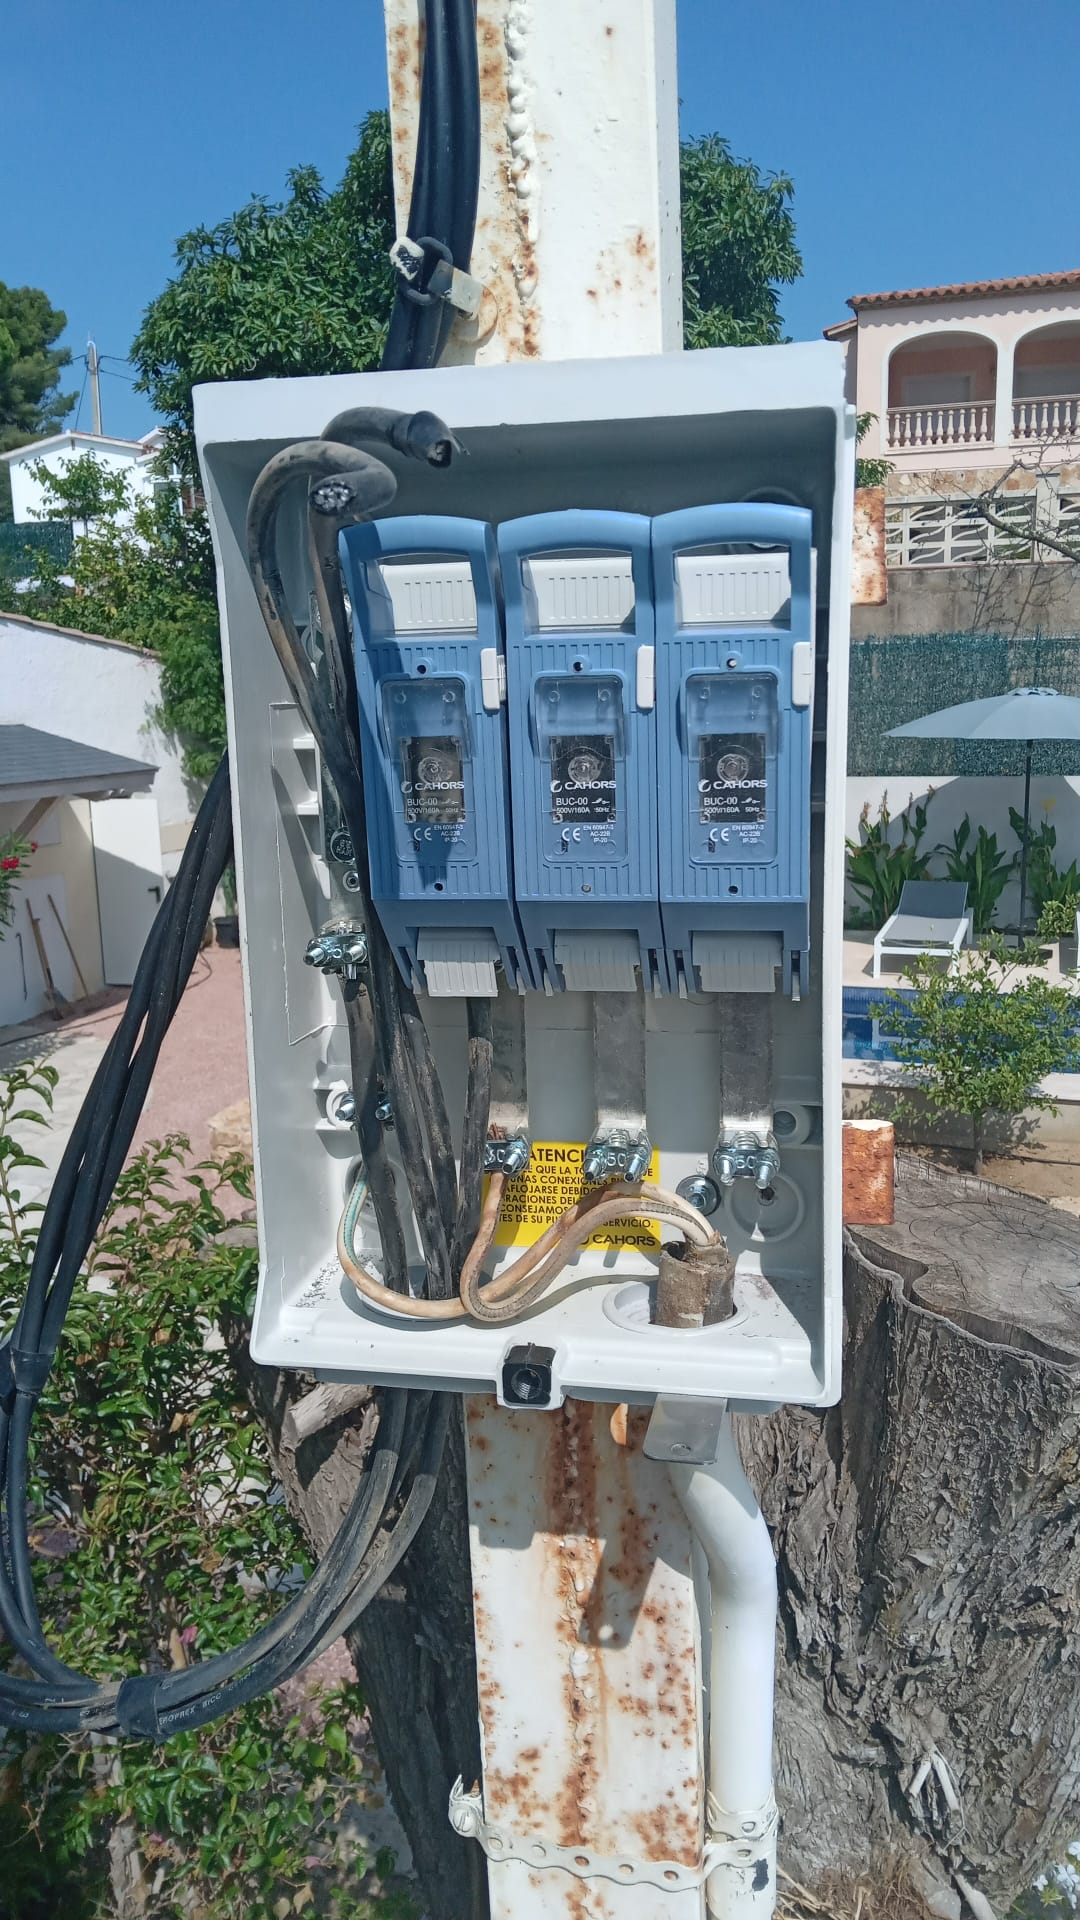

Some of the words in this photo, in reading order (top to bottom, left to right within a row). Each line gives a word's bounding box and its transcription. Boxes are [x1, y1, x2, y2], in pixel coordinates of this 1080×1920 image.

[414, 781, 465, 790] CAHORS
[565, 781, 617, 790] CAHORS
[713, 780, 768, 790] CAHORS
[407, 798, 438, 806] BUC-00
[556, 797, 588, 806] BUC-00
[703, 797, 738, 806] BUC-00
[414, 827, 432, 841] CE
[562, 828, 581, 842] CE
[710, 828, 729, 842] CE
[530, 1148, 584, 1163] ATENCI
[607, 1152, 626, 1167] 50
[535, 1165, 557, 1175] QUE
[559, 1166, 571, 1175] LA
[510, 1175, 537, 1184] UNAS
[504, 1194, 557, 1204] RACIONES
[499, 1213, 513, 1223] TES
[516, 1214, 528, 1223] DE
[531, 1214, 543, 1224] SU
[546, 1215, 558, 1224] PU
[592, 1233, 656, 1246] CAHORS
